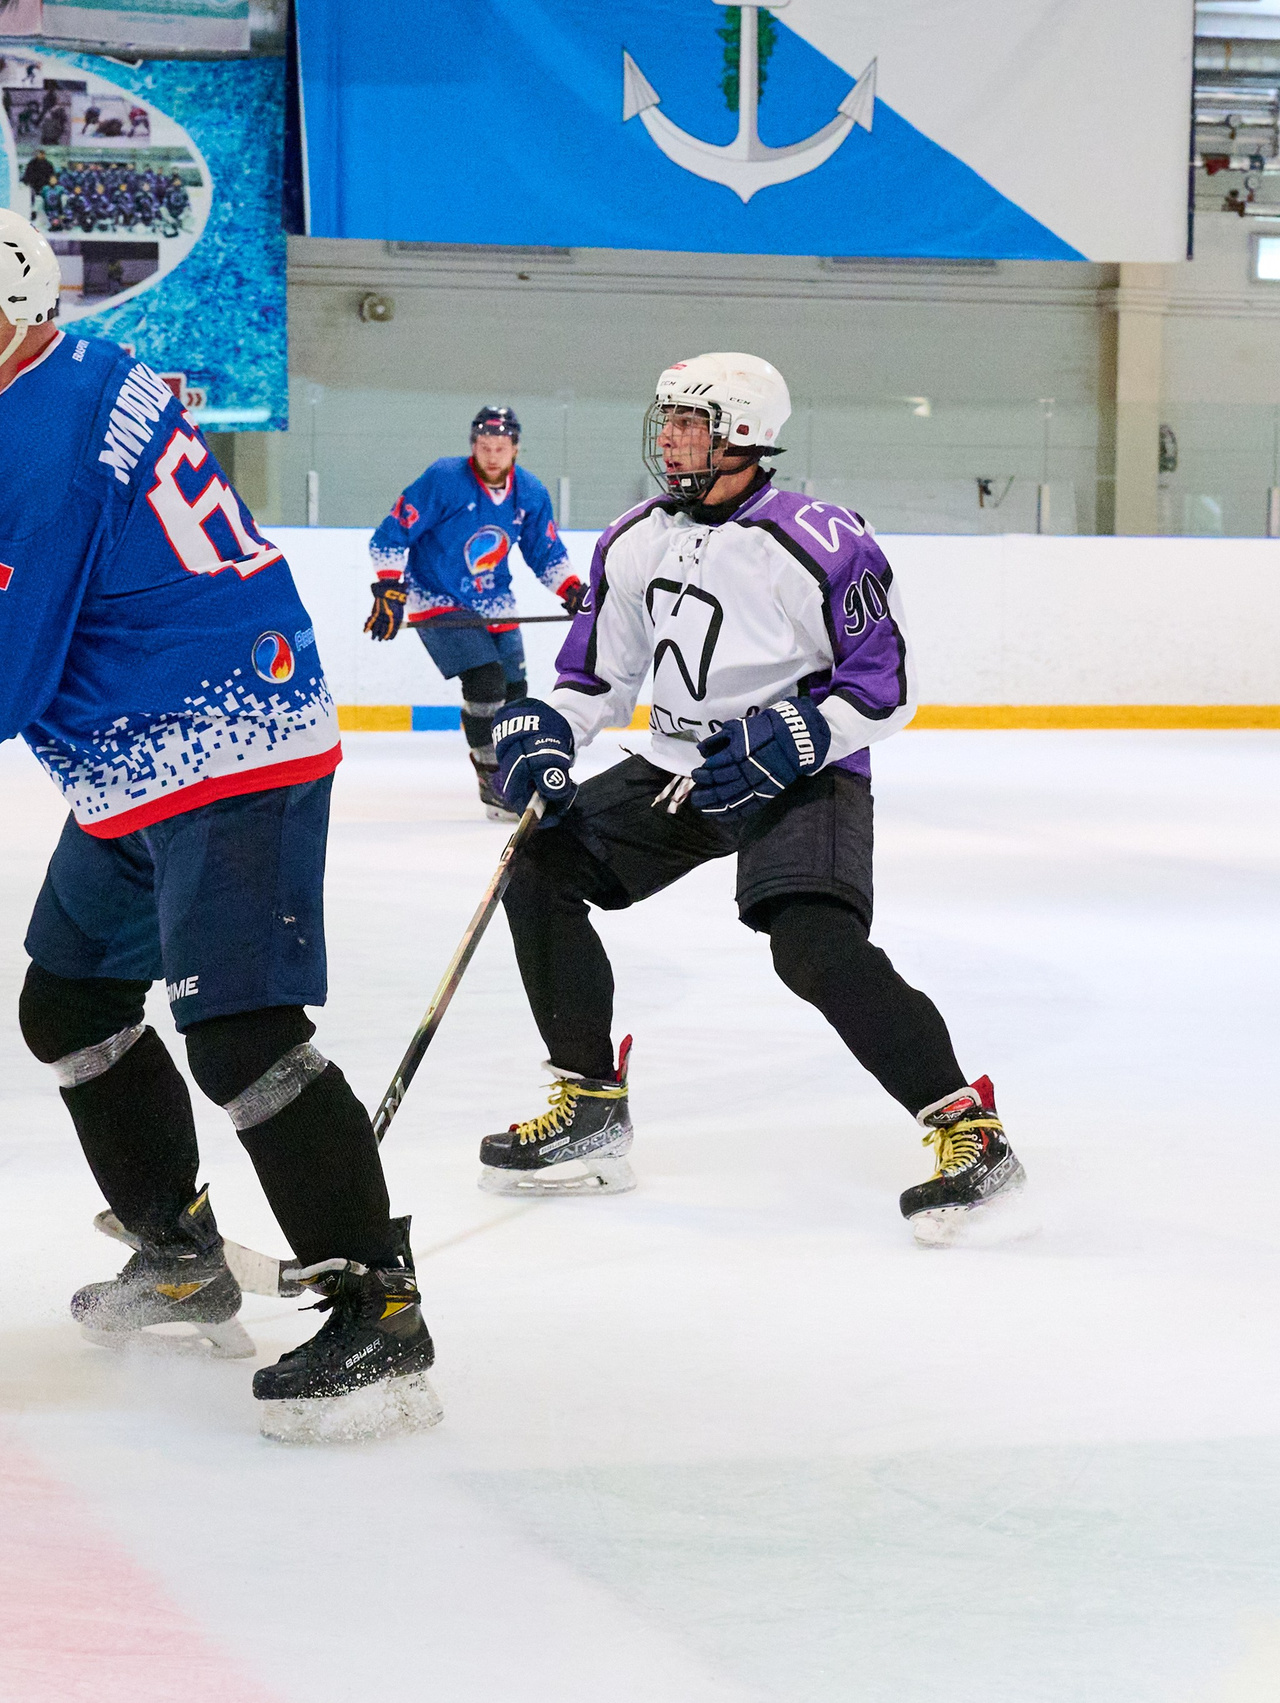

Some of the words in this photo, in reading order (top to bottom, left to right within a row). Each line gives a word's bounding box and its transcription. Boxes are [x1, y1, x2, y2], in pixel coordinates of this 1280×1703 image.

[728, 396, 752, 405] CCM
[146, 410, 283, 581] 6
[843, 569, 889, 637] 90
[491, 715, 540, 746] RIOR
[345, 1338, 382, 1369] BAUER
